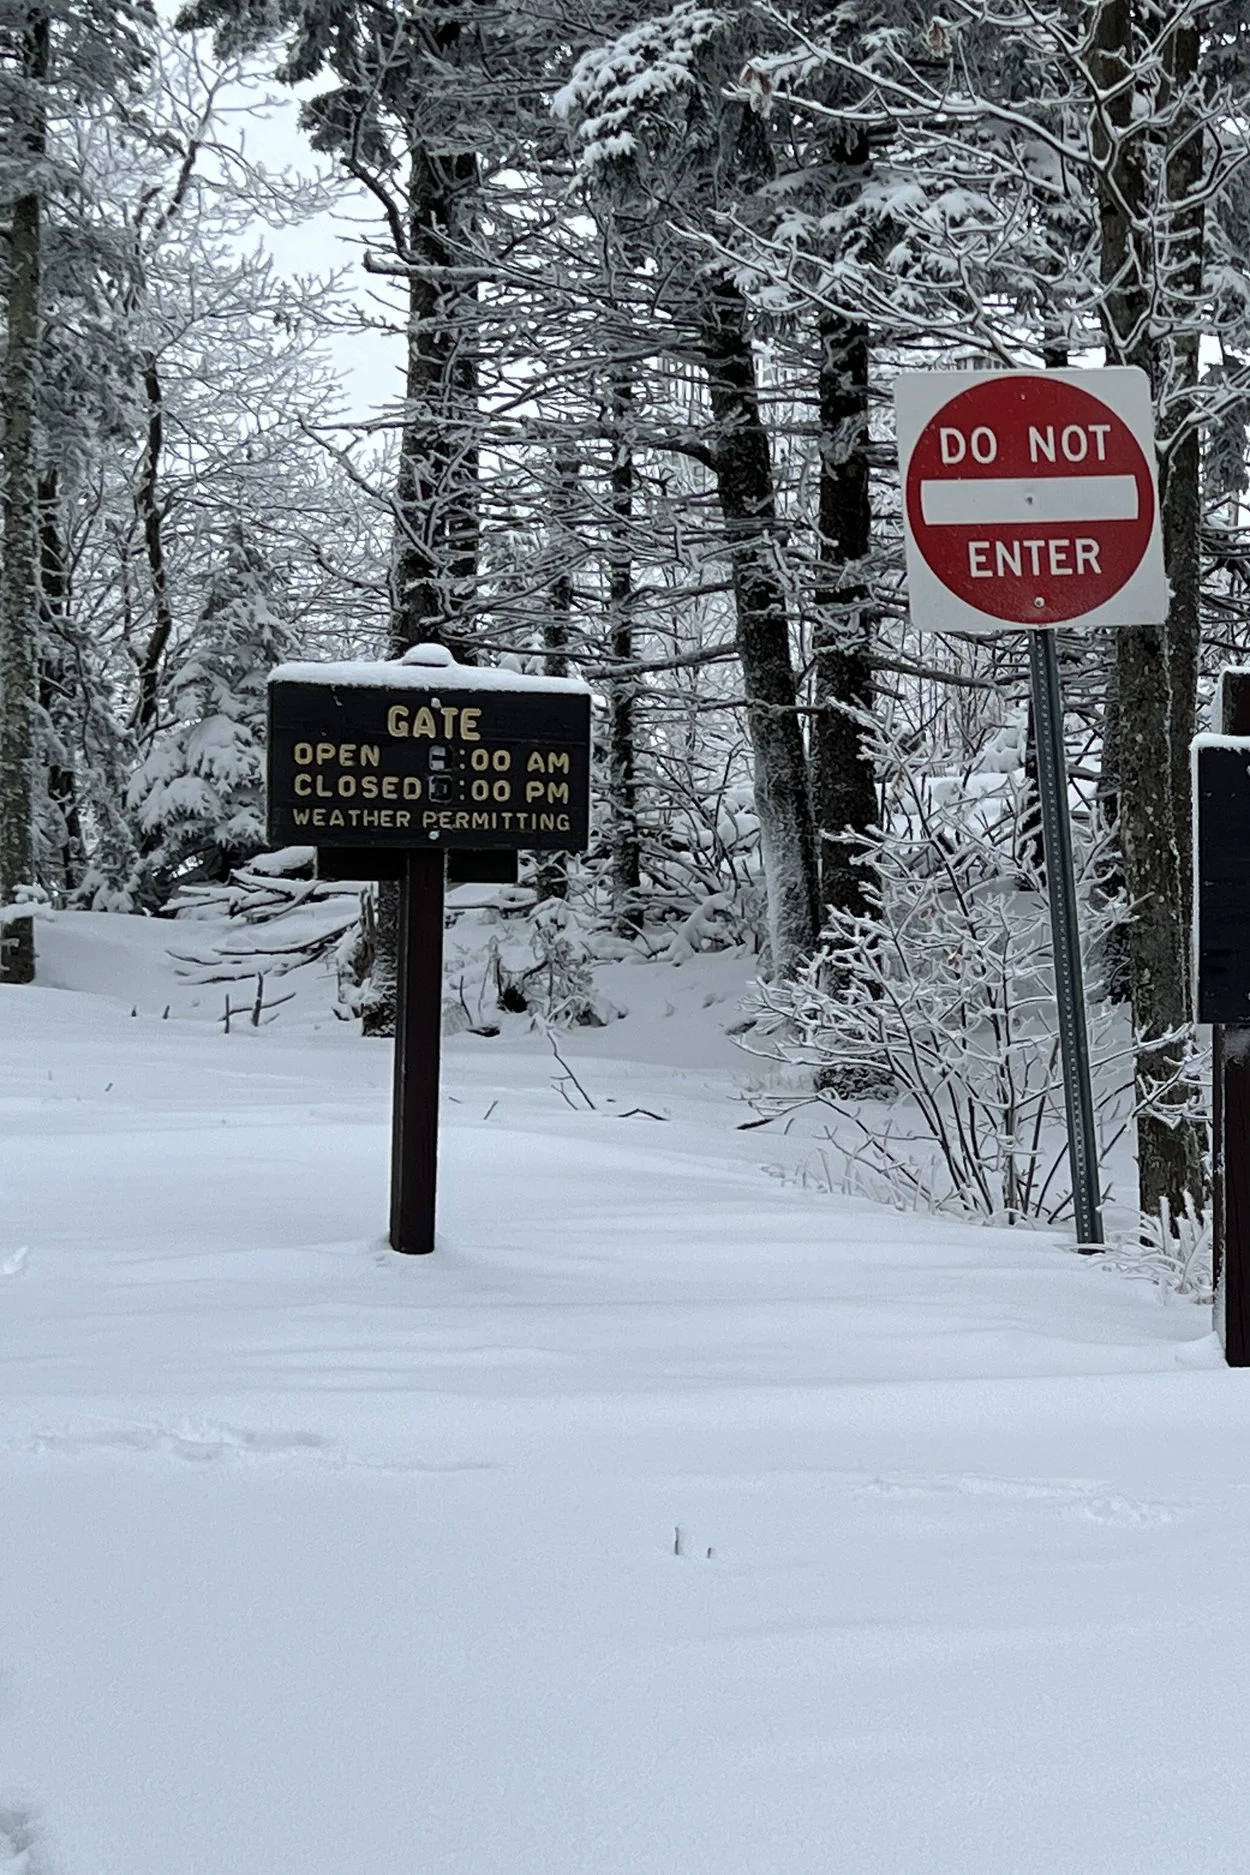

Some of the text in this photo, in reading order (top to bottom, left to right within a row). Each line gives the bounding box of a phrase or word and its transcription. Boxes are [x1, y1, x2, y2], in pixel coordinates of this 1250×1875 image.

[940, 424, 1111, 464] DO NOT
[968, 538, 1102, 578] ENTER
[387, 705, 482, 741] GATE
[294, 743, 380, 767] OPEN
[527, 752, 570, 774] AM
[294, 774, 422, 800] CLOSED
[526, 781, 570, 804] PM
[292, 808, 571, 831] WEATHER PERMITTING
